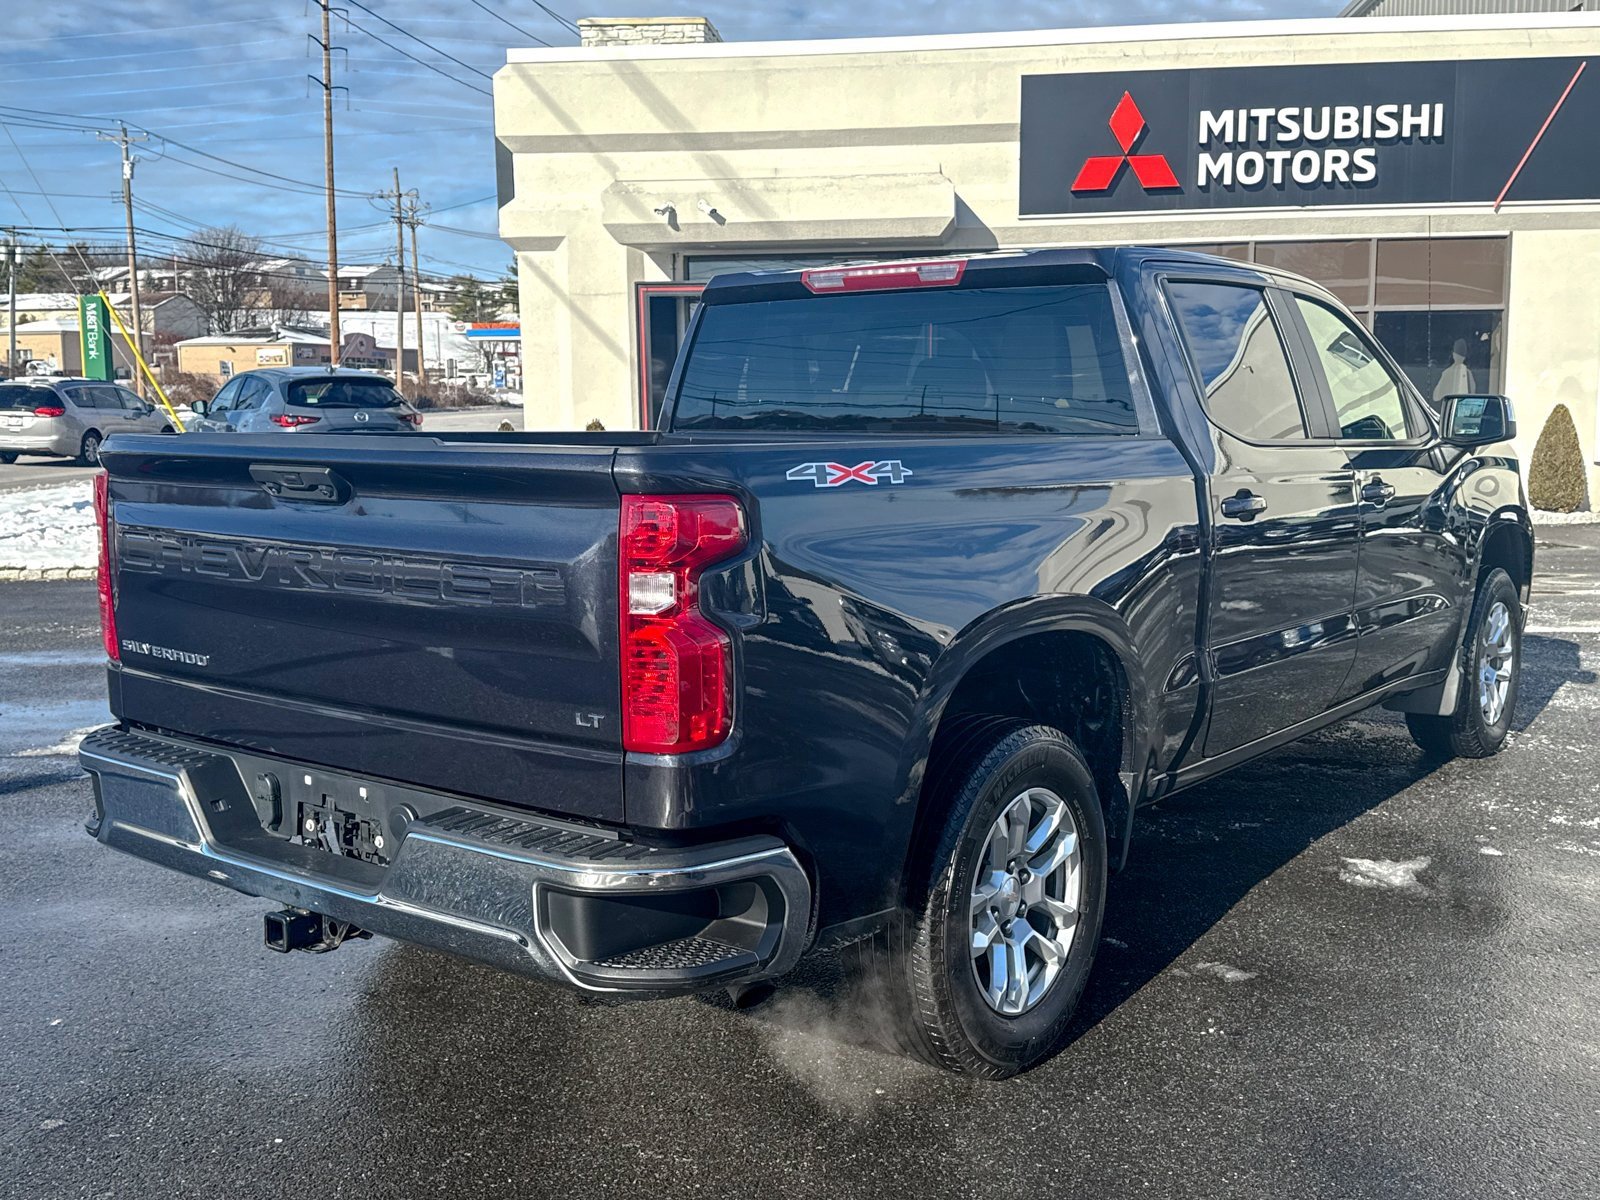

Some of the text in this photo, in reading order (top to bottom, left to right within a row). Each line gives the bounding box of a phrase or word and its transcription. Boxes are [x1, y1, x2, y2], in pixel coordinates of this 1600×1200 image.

[1199, 103, 1444, 144] MITSUBISHI
[1198, 148, 1377, 187] MOTORS
[86, 302, 99, 360] M&T Bank
[119, 531, 563, 608] CHEVROLET
[122, 639, 210, 667] SILVERADO
[575, 712, 605, 729] LT
